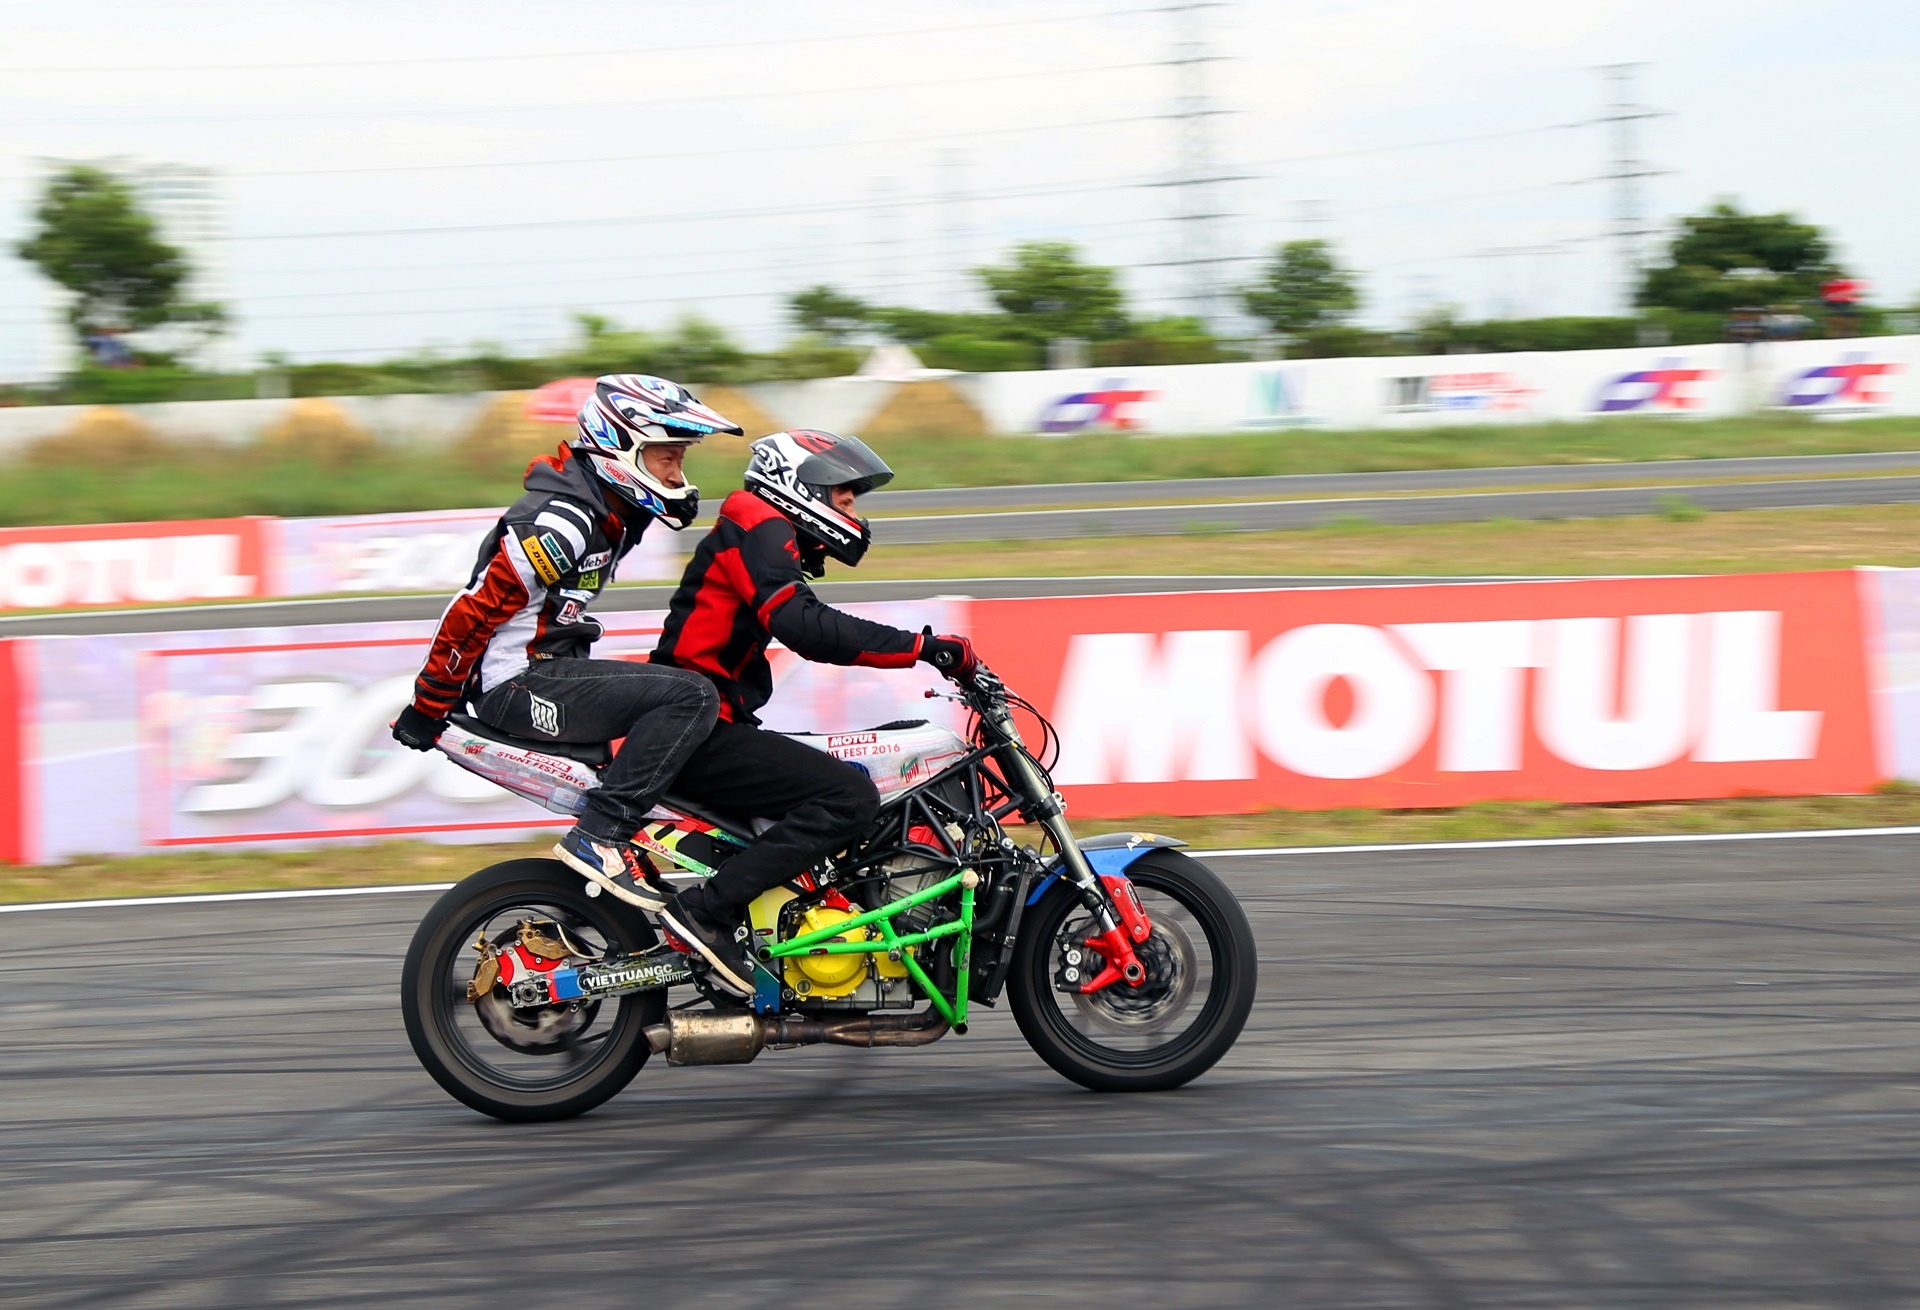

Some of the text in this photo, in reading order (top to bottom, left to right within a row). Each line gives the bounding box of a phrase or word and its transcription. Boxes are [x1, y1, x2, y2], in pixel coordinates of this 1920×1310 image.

[604, 461, 626, 482] SHOEI
[758, 486, 851, 545] SCORPION
[0, 534, 257, 607] OTUL
[1055, 609, 1823, 785] MOTUL
[831, 734, 874, 747] MOTUL
[843, 746, 868, 758] FEST
[872, 743, 901, 756] 2016
[496, 751, 533, 765] STUNT
[532, 761, 558, 775] FEST
[557, 771, 587, 789] 2016
[526, 752, 570, 772] MOTUL
